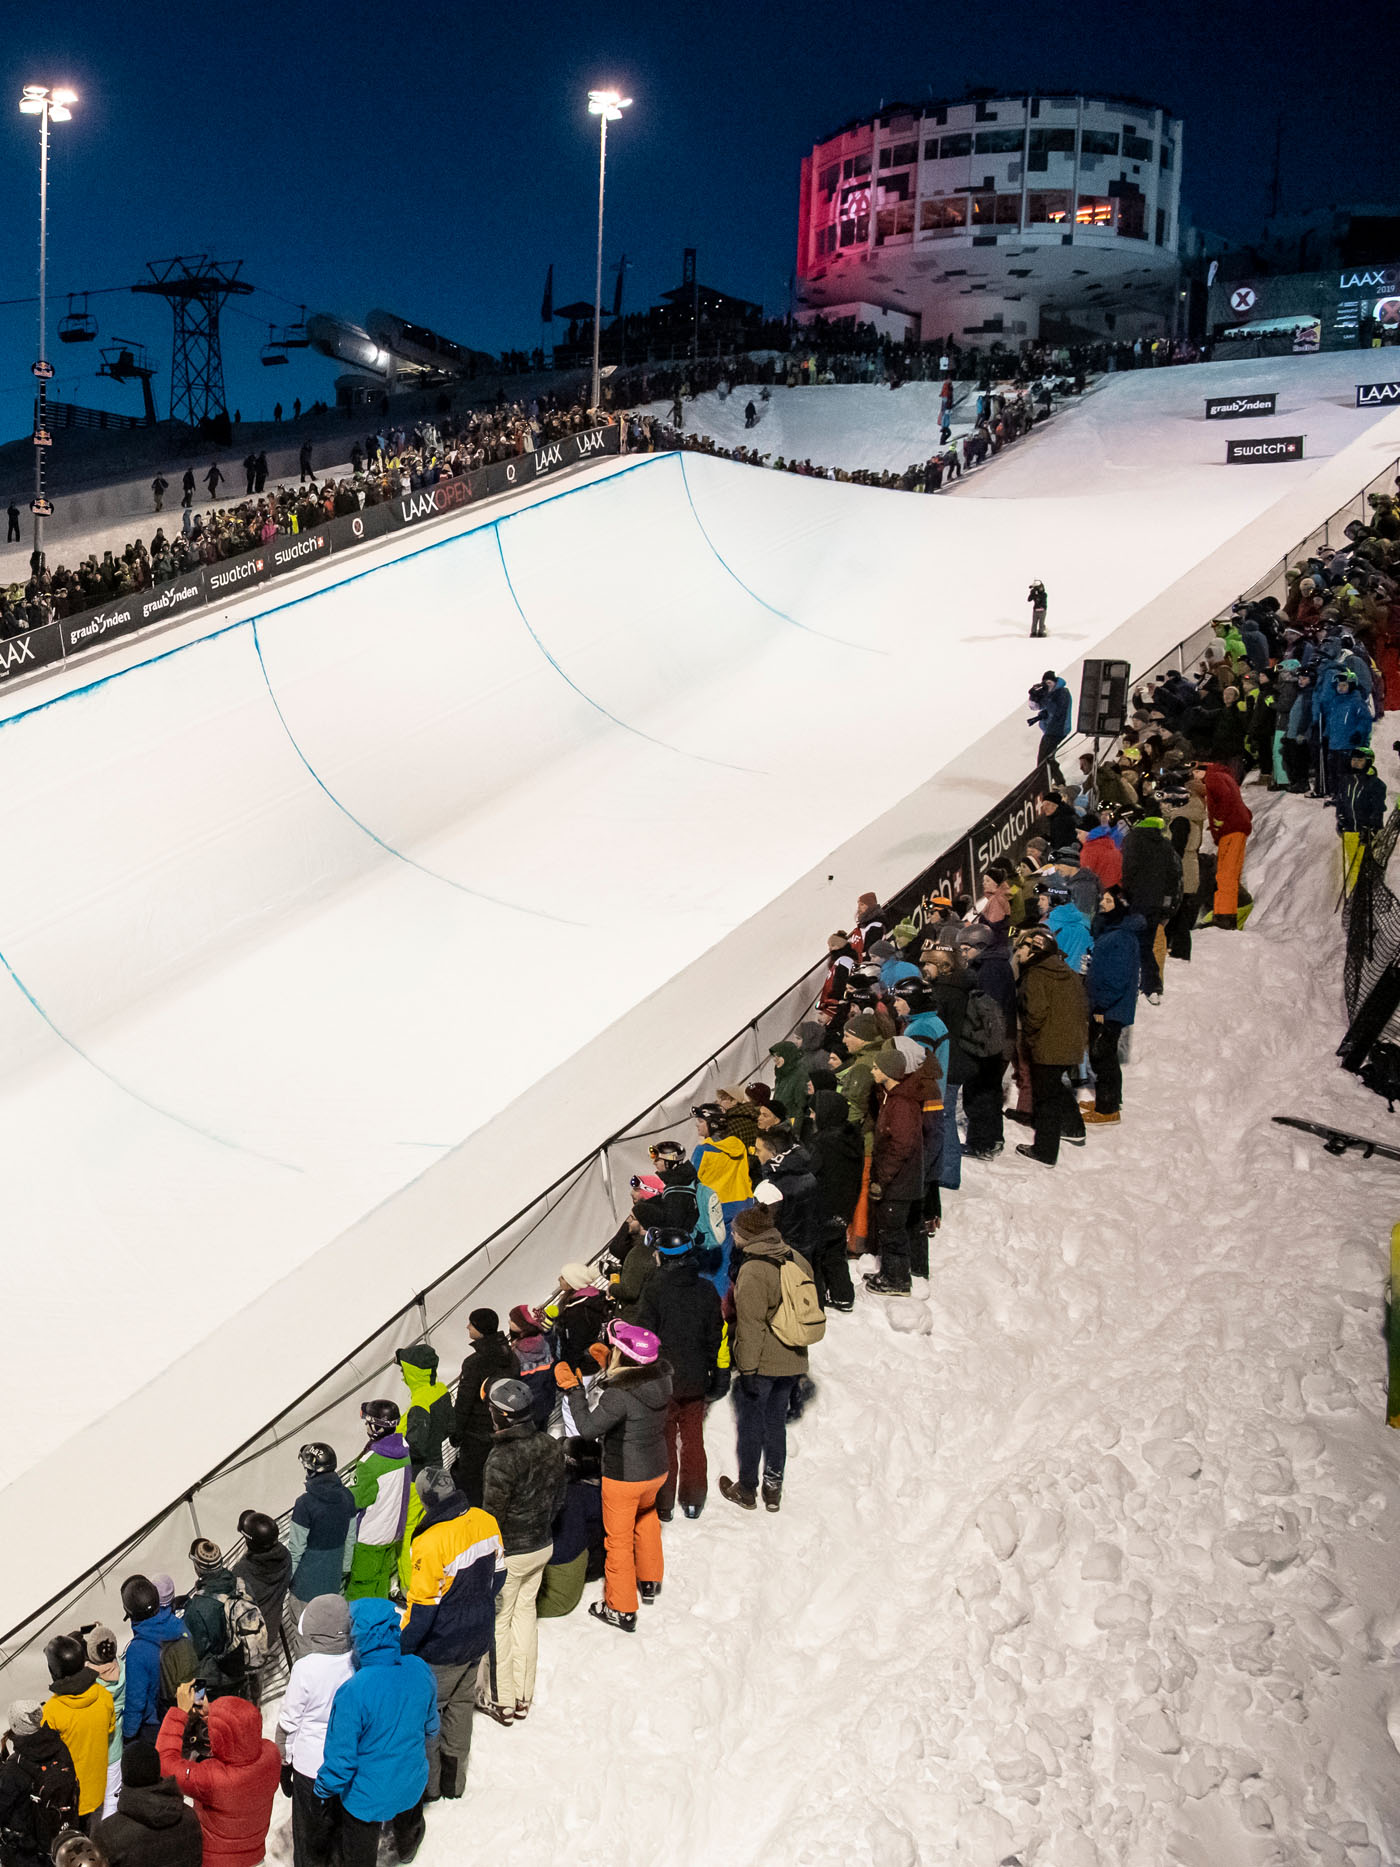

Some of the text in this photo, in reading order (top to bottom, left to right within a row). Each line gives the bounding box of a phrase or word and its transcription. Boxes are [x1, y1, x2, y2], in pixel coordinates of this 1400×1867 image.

[576, 430, 605, 453] LAAX
[1233, 442, 1286, 456] swatch
[535, 443, 563, 471] LAAX
[274, 537, 318, 565] swatch
[210, 560, 257, 590] swatch
[978, 800, 1035, 873] swatch
